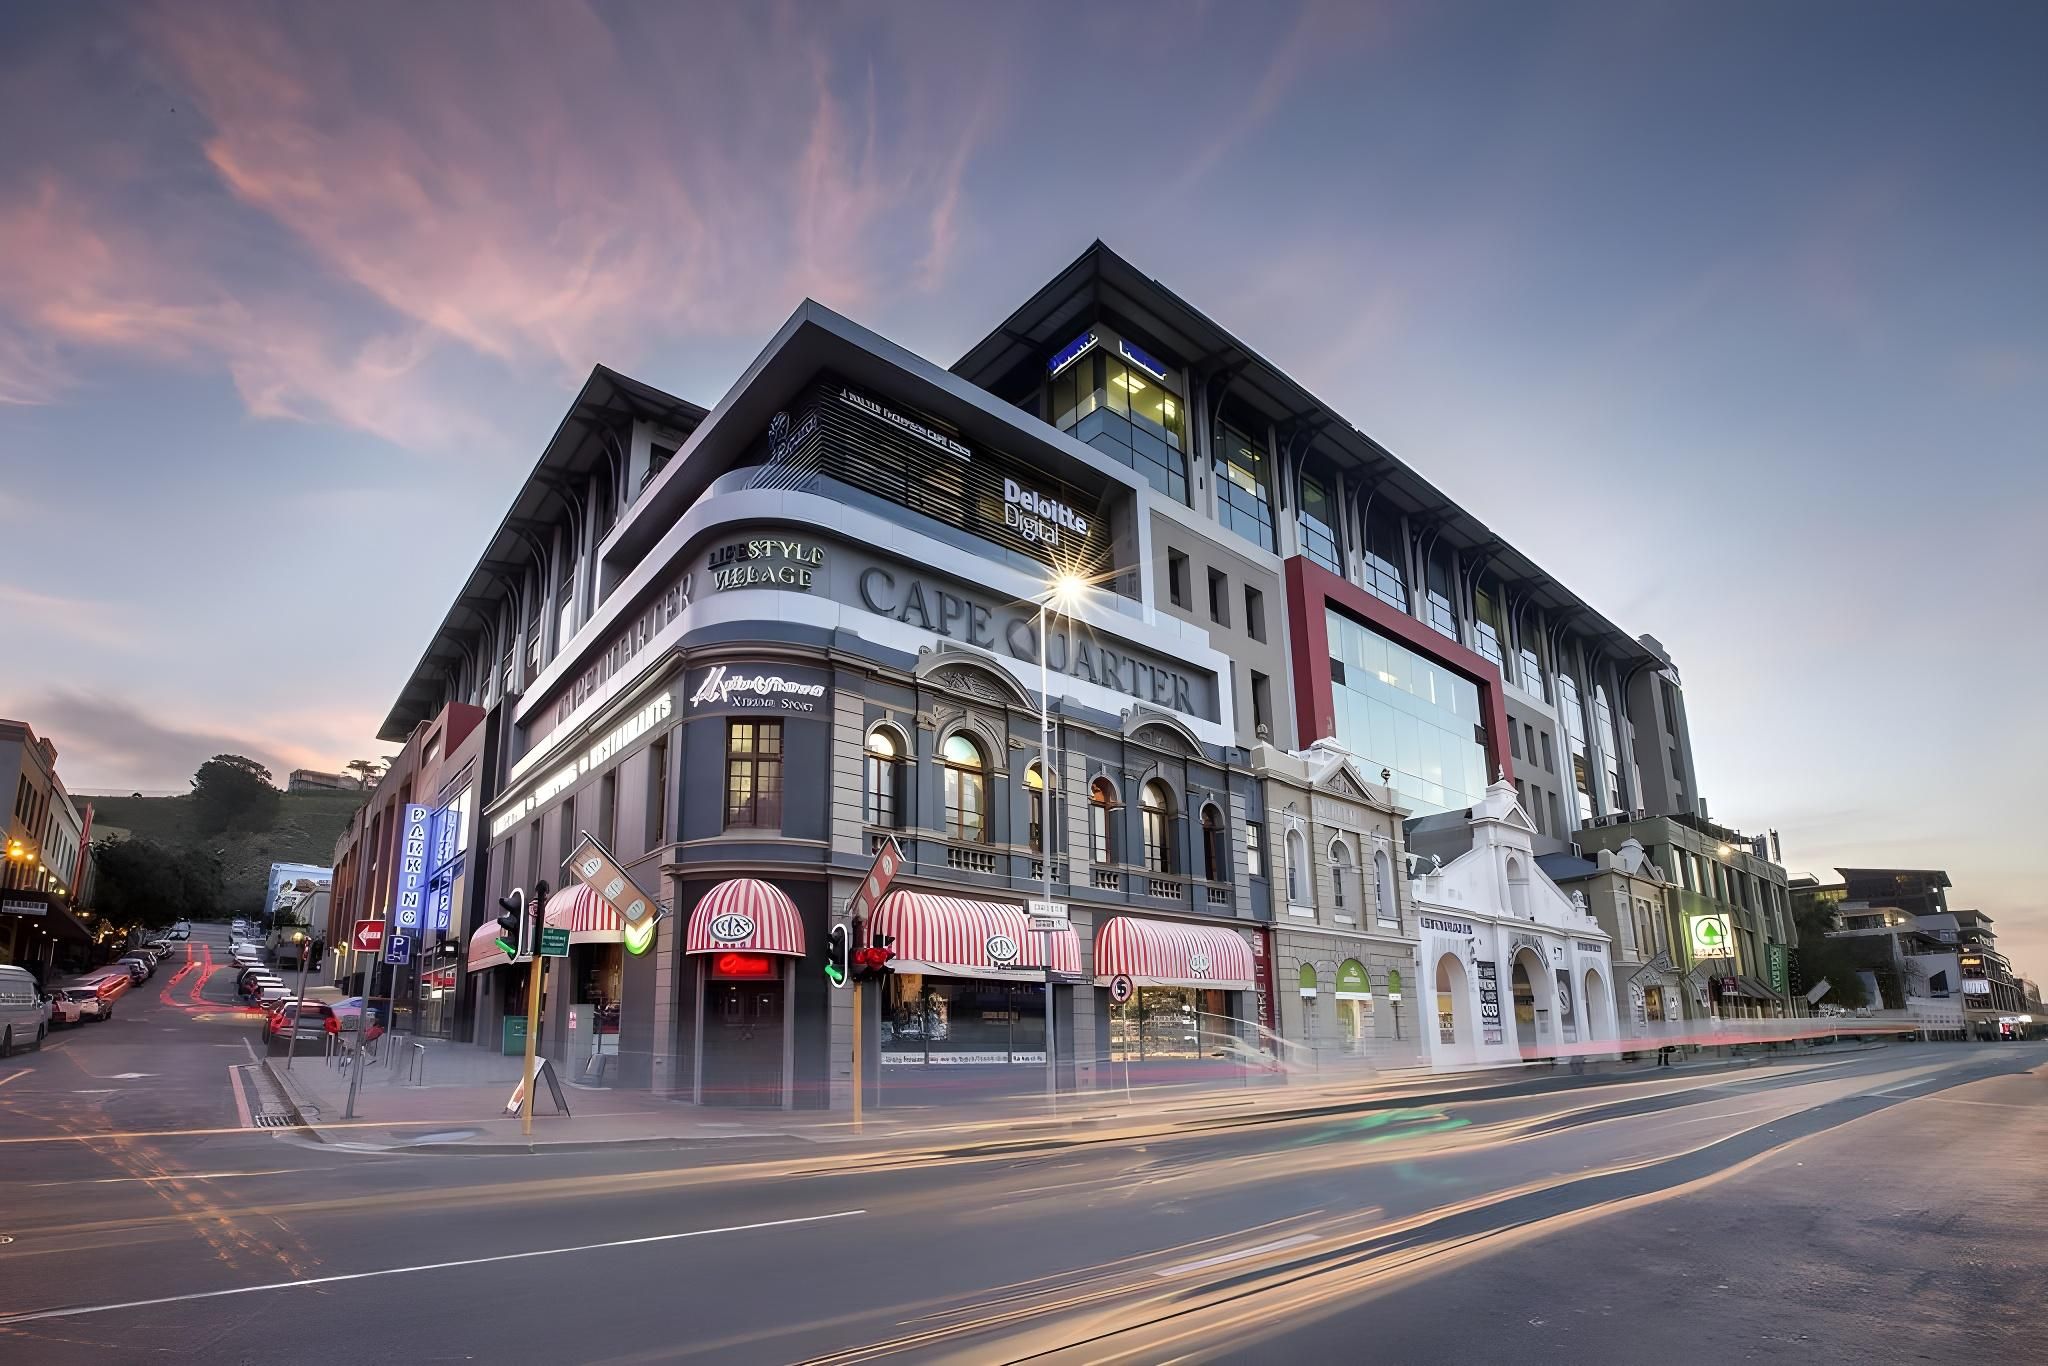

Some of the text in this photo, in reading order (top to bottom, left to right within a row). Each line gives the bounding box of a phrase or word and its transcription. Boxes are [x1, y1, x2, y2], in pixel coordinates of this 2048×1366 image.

[1004, 502, 1059, 546] Digital
[859, 566, 1196, 717] CAPE QUARTER
[393, 937, 404, 950] P
